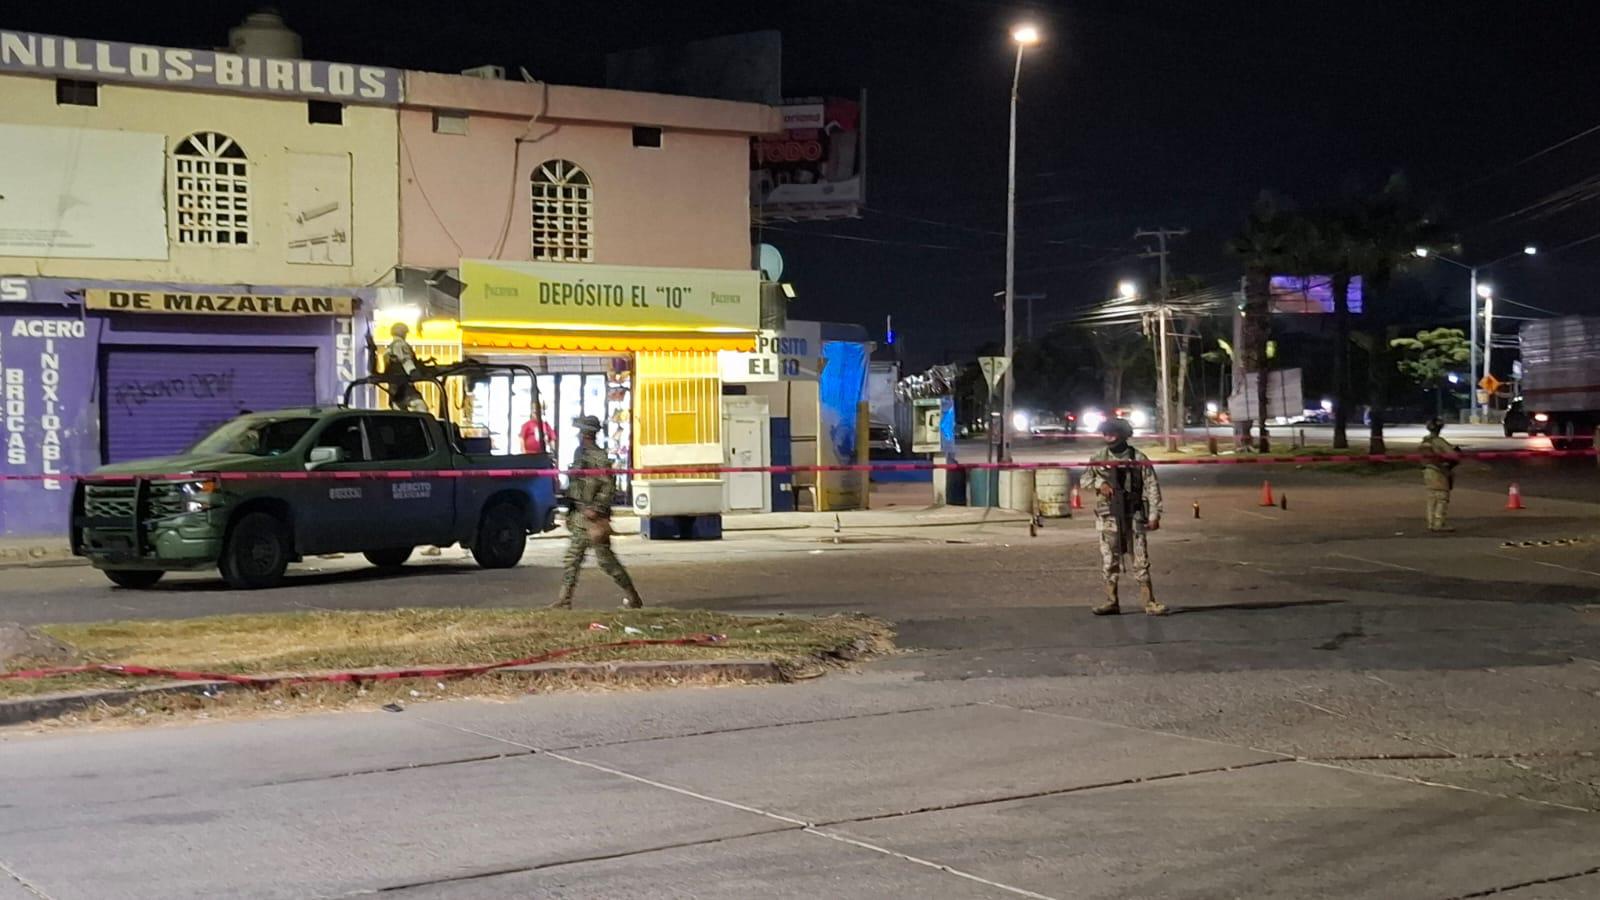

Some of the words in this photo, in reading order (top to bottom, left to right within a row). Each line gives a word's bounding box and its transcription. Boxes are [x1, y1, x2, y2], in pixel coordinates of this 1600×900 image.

[109, 291, 150, 309] DE
[163, 293, 334, 313] MAZATLAN
[539, 278, 623, 307] DEPÓSITO
[631, 285, 649, 308] EL
[12, 319, 86, 338] ACERO
[748, 358, 775, 376] EL
[783, 357, 800, 376] 10
[6, 368, 27, 465] BROCAS
[41, 339, 61, 490] INOXIDABLE
